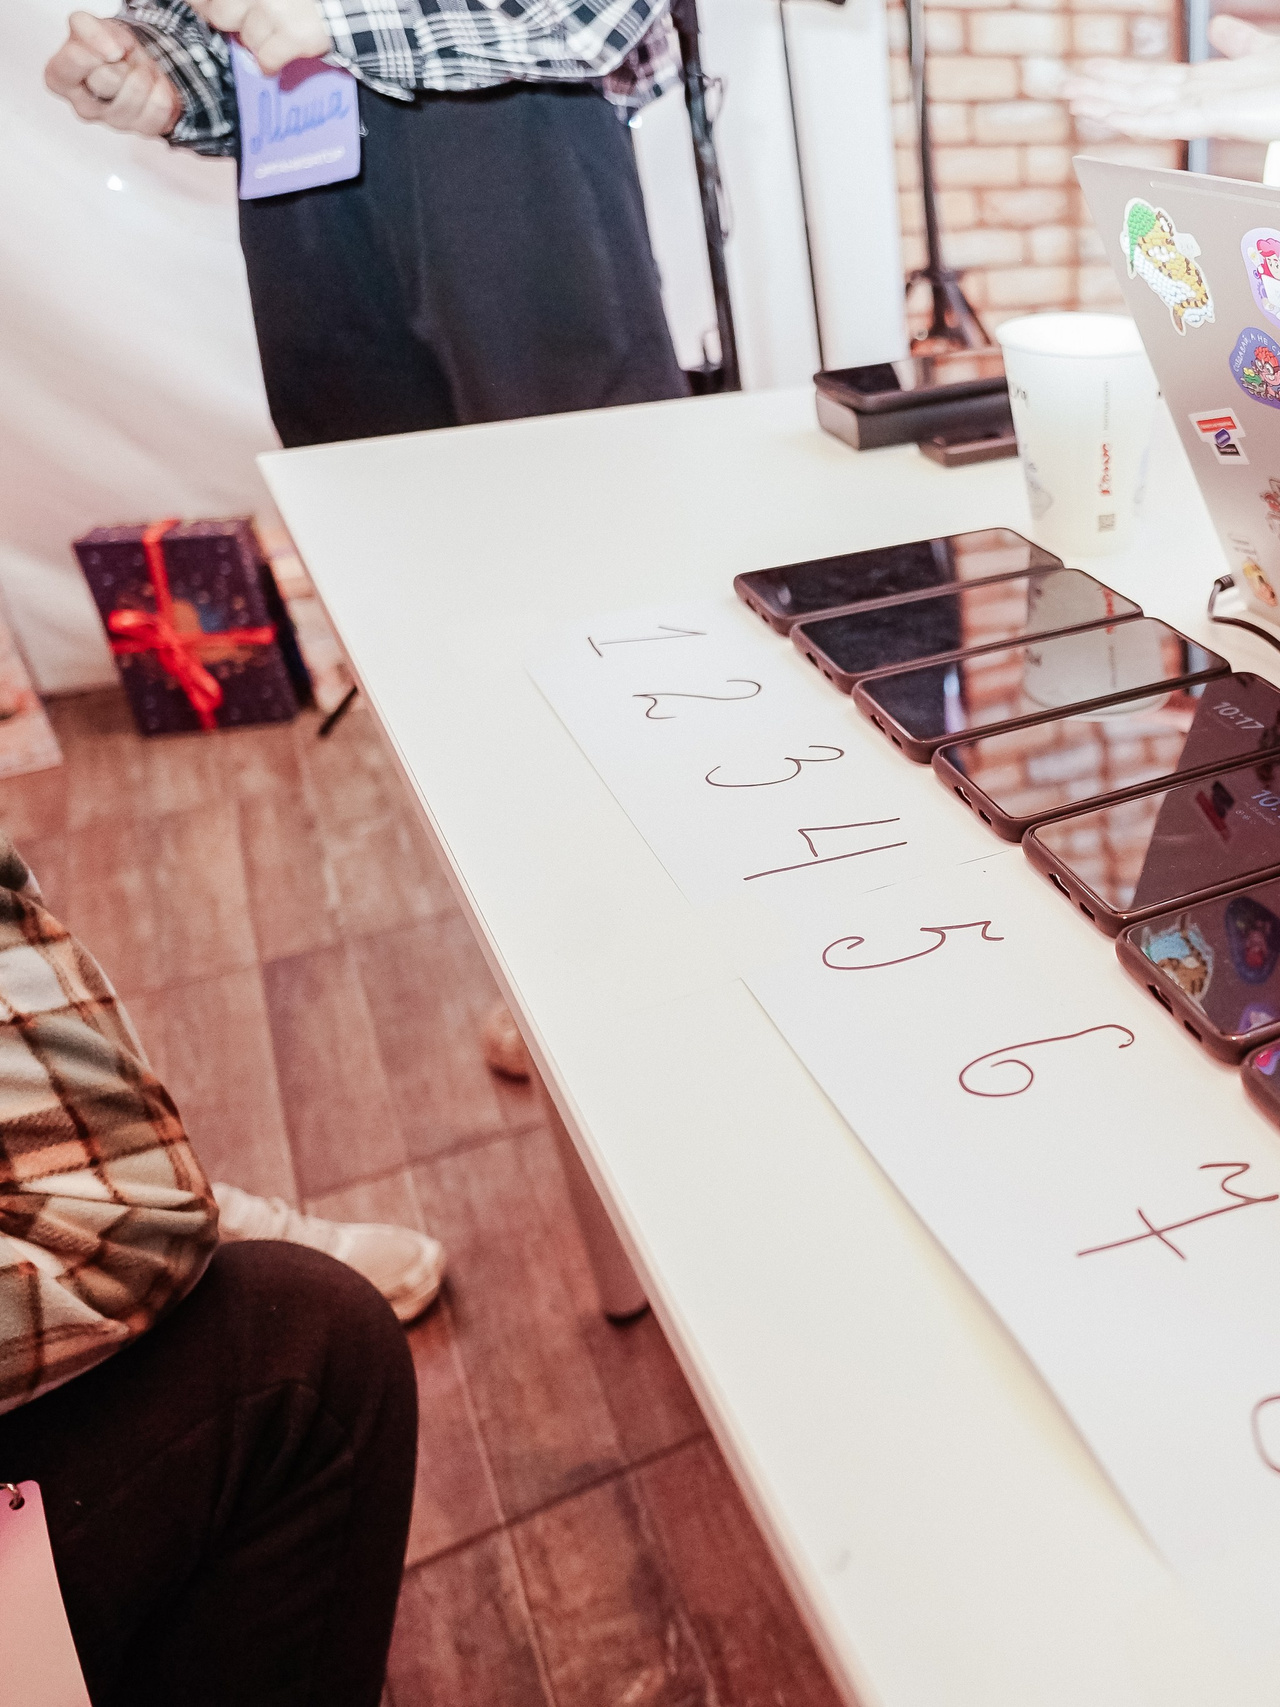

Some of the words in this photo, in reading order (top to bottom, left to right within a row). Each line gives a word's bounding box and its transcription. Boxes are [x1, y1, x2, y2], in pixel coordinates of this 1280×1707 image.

[1257, 334, 1268, 346] НЕ
[587, 625, 708, 658] 1
[632, 678, 762, 720] 2
[1212, 701, 1265, 731] 10:17
[705, 744, 845, 788] 3
[743, 816, 908, 881] 4
[822, 920, 1005, 970] 5
[958, 1024, 1136, 1098] 6
[1075, 1162, 1280, 1262] 7
